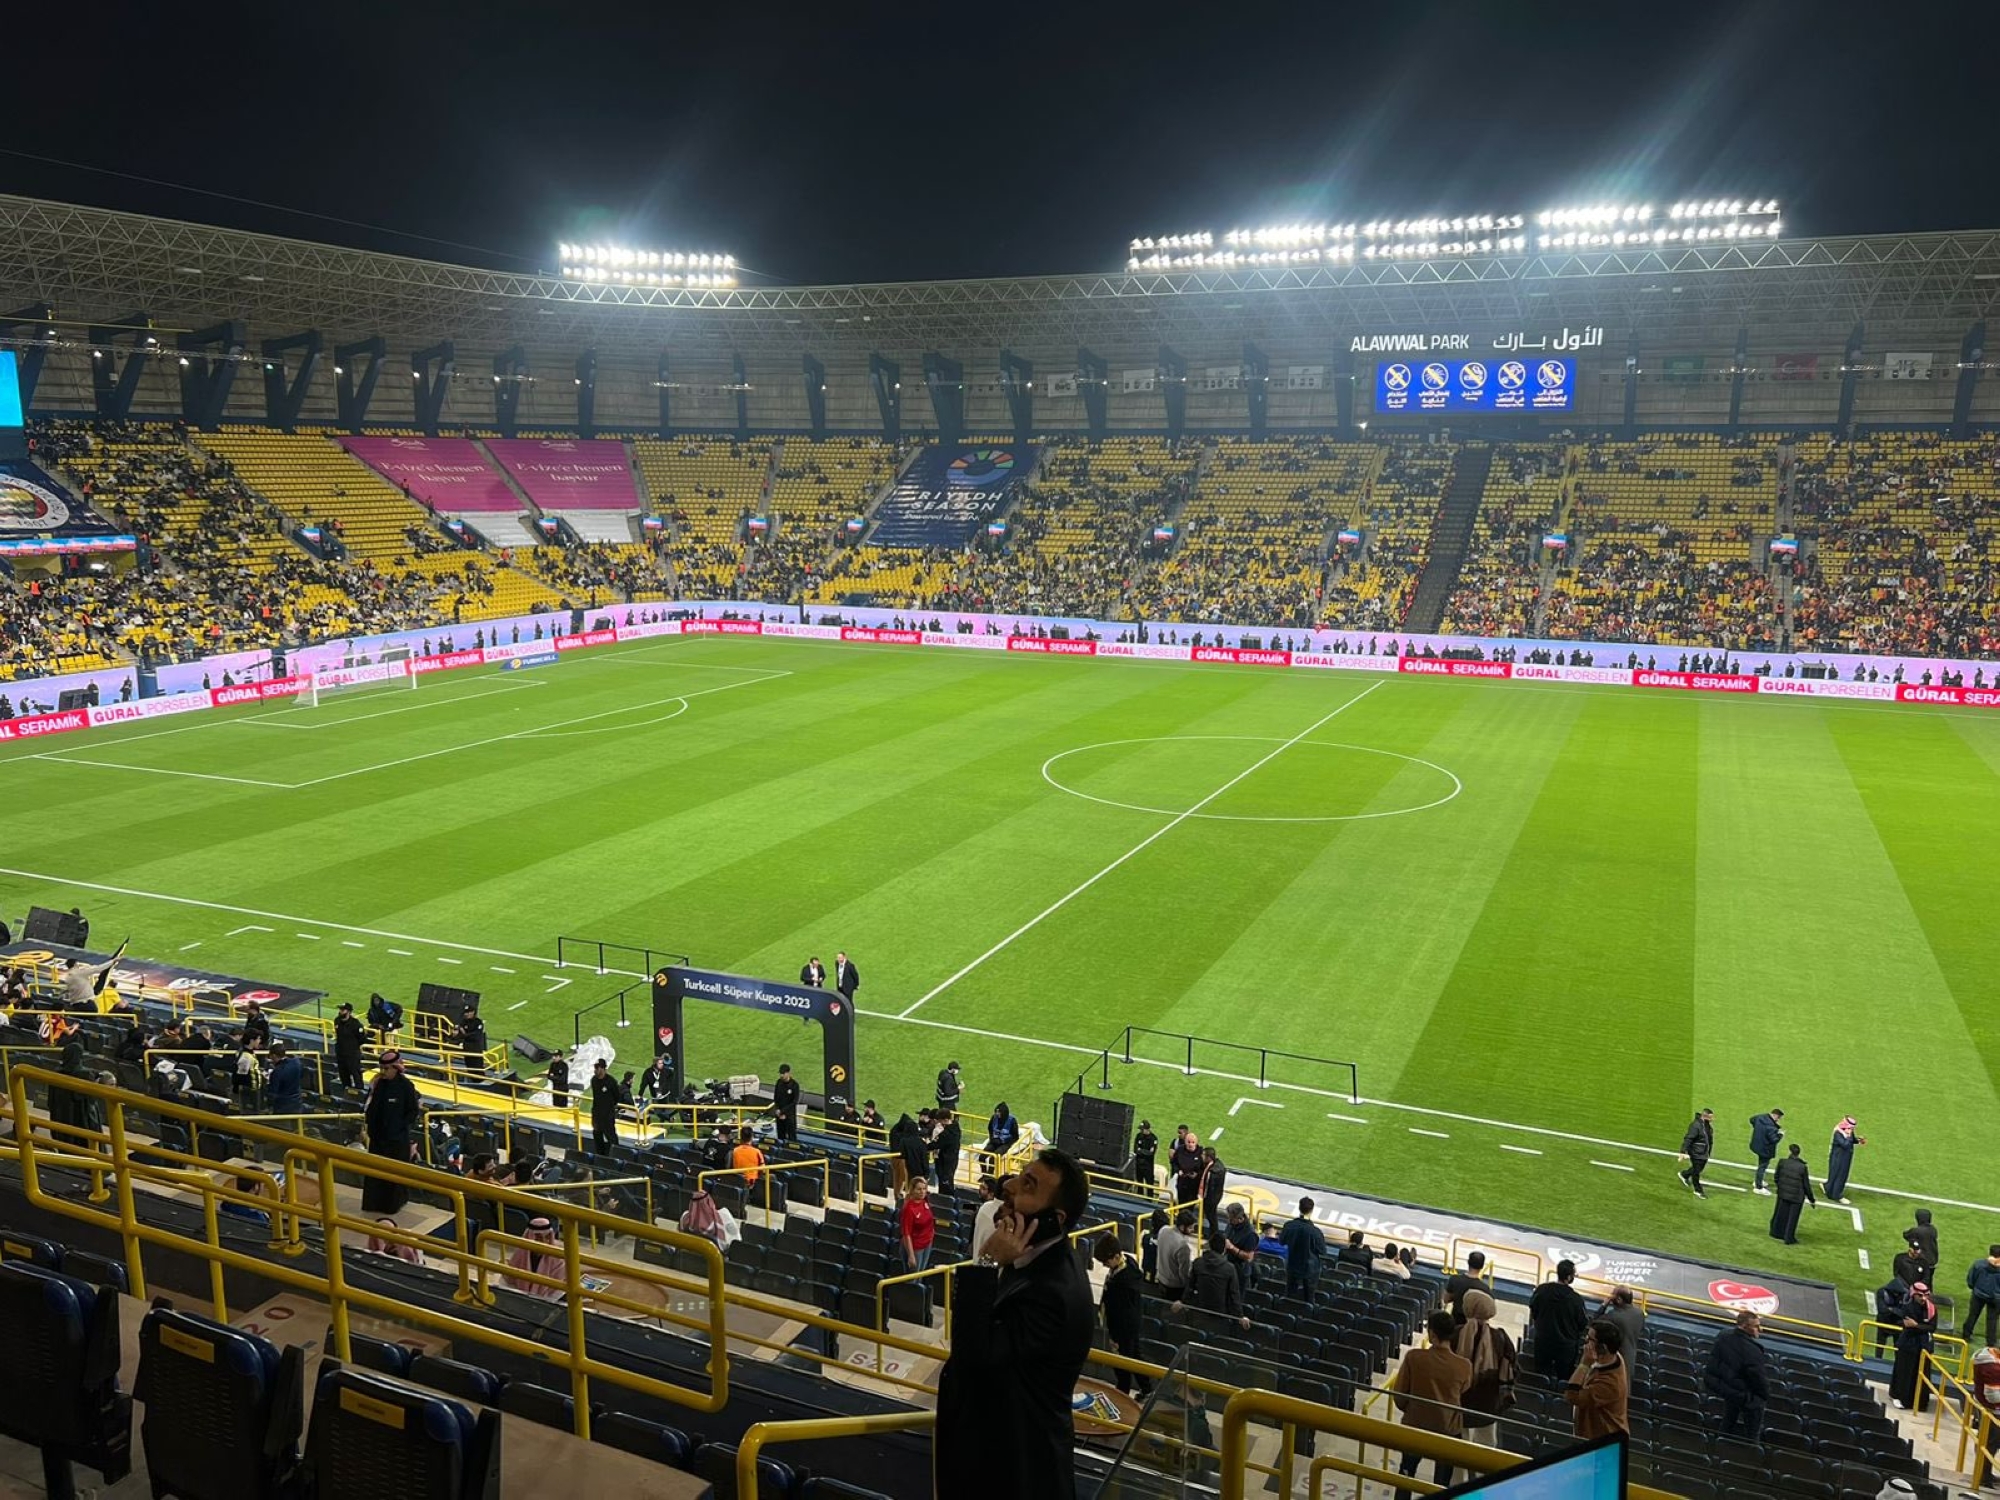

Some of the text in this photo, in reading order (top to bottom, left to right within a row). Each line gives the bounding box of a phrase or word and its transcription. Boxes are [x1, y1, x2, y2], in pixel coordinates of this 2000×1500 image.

[1350, 334, 1470, 351] ALAWWAL PARK
[1553, 327, 1603, 349] الأول
[574, 463, 623, 472] hemen
[918, 492, 1003, 500] RIYADH
[911, 502, 996, 511] SEASON
[685, 620, 718, 632] GÜRAL
[845, 628, 918, 642] GÜRAL SERAMİK
[924, 634, 1004, 648] GÜRAL PORSELEN
[1011, 639, 1091, 653] GÜRAL SERAMİK
[1100, 644, 1188, 659] GÜRAL PORSELEN
[1196, 649, 1286, 664] GÜRAL SERAMİK
[1295, 655, 1396, 670] GÜRAL PORSELEN
[1405, 660, 1506, 676] GÜRAL SERAMİK
[1516, 667, 1628, 683] GÜRAL PORSELEN
[1638, 673, 1753, 690] GÜRAL SERAMİK
[217, 688, 260, 704] GÜRAL
[1764, 681, 1891, 698] GÜRAL PORSELEN
[1904, 686, 1959, 702] GÜRAL
[93, 695, 211, 723] GÜRAL PORSELEN
[18, 716, 83, 735] SERAMİK
[683, 978, 811, 1009] Turkcell Süper Kupa 2023
[1603, 1266, 1653, 1276] SÜPER
[1604, 1260, 1659, 1269] TURKCELL
[1603, 1274, 1645, 1284] KUPA
